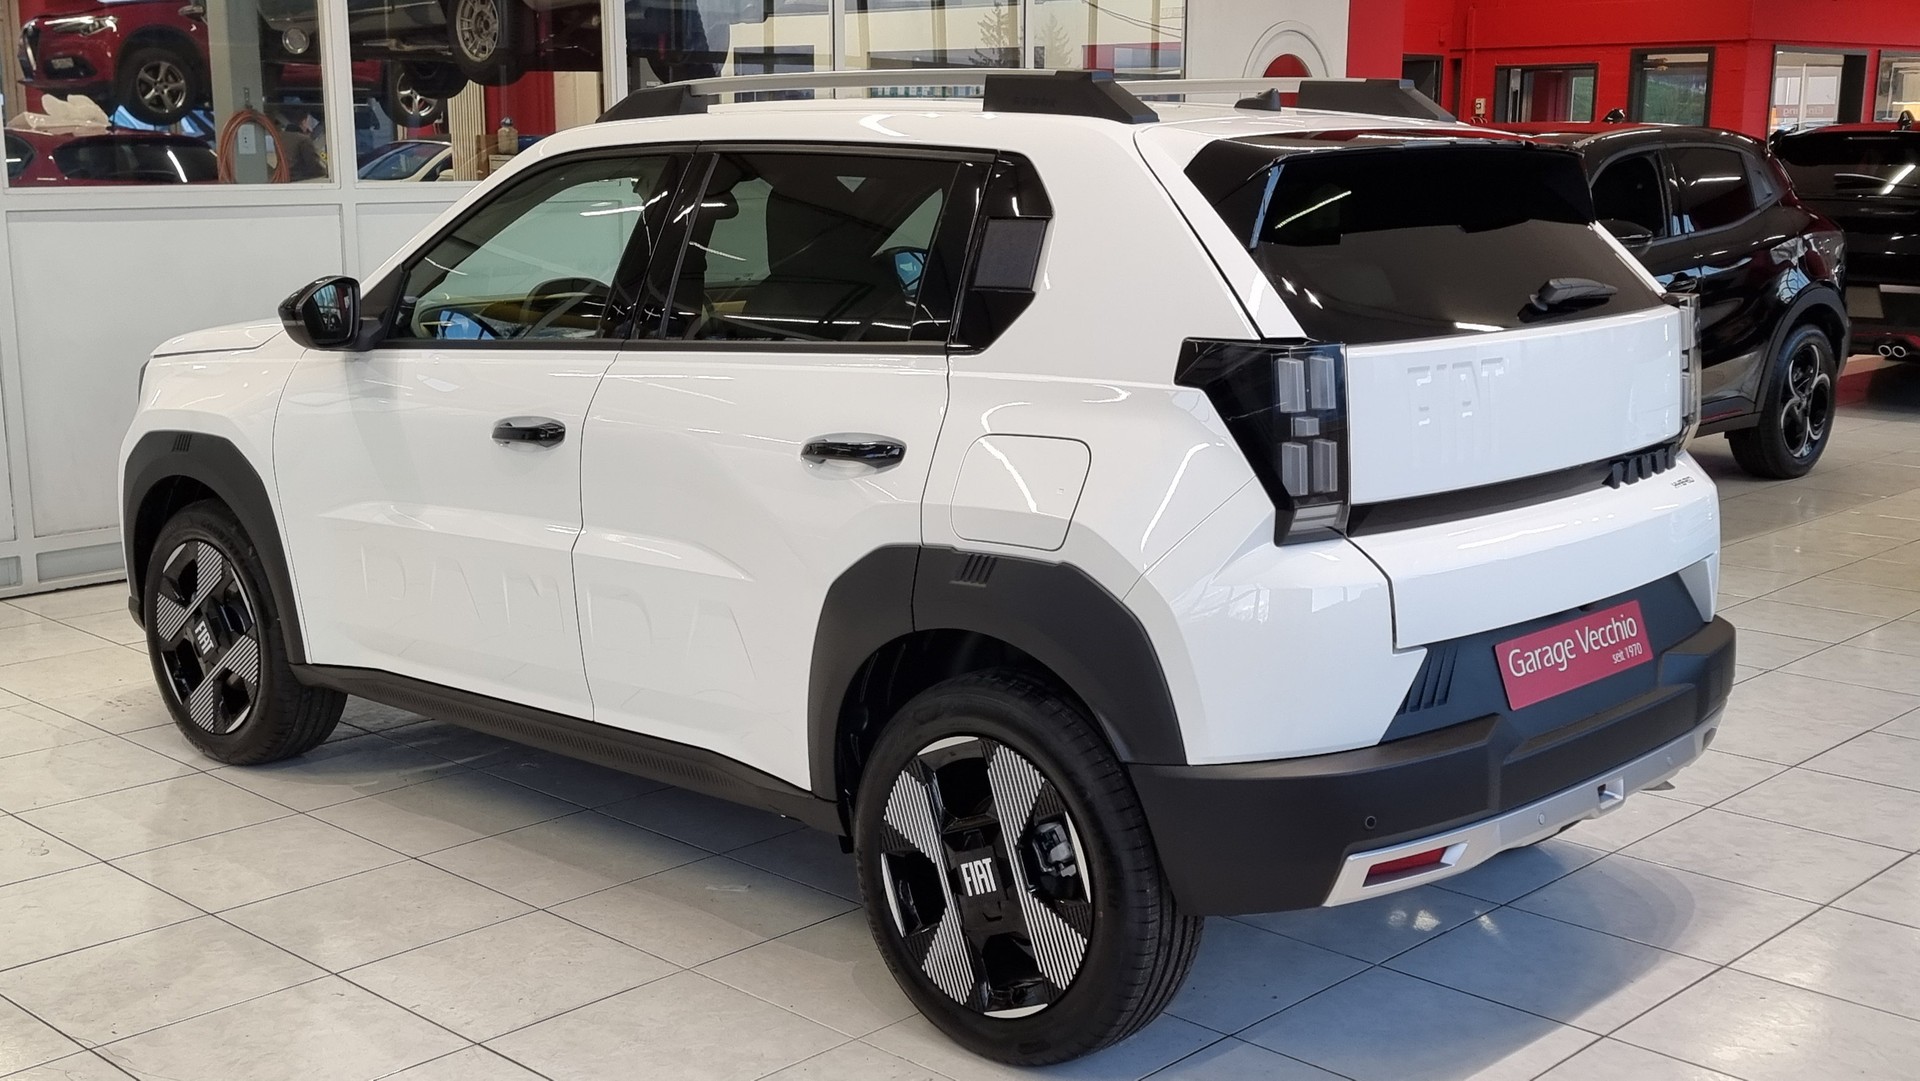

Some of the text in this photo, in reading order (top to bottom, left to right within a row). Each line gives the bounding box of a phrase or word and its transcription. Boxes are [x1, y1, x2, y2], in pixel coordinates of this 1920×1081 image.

[1406, 357, 1506, 462] FIAT
[194, 620, 214, 654] FIAT
[1508, 614, 1637, 677] Garage Vecchio
[1612, 642, 1643, 664] seit 1970
[960, 857, 997, 897] FIAT
